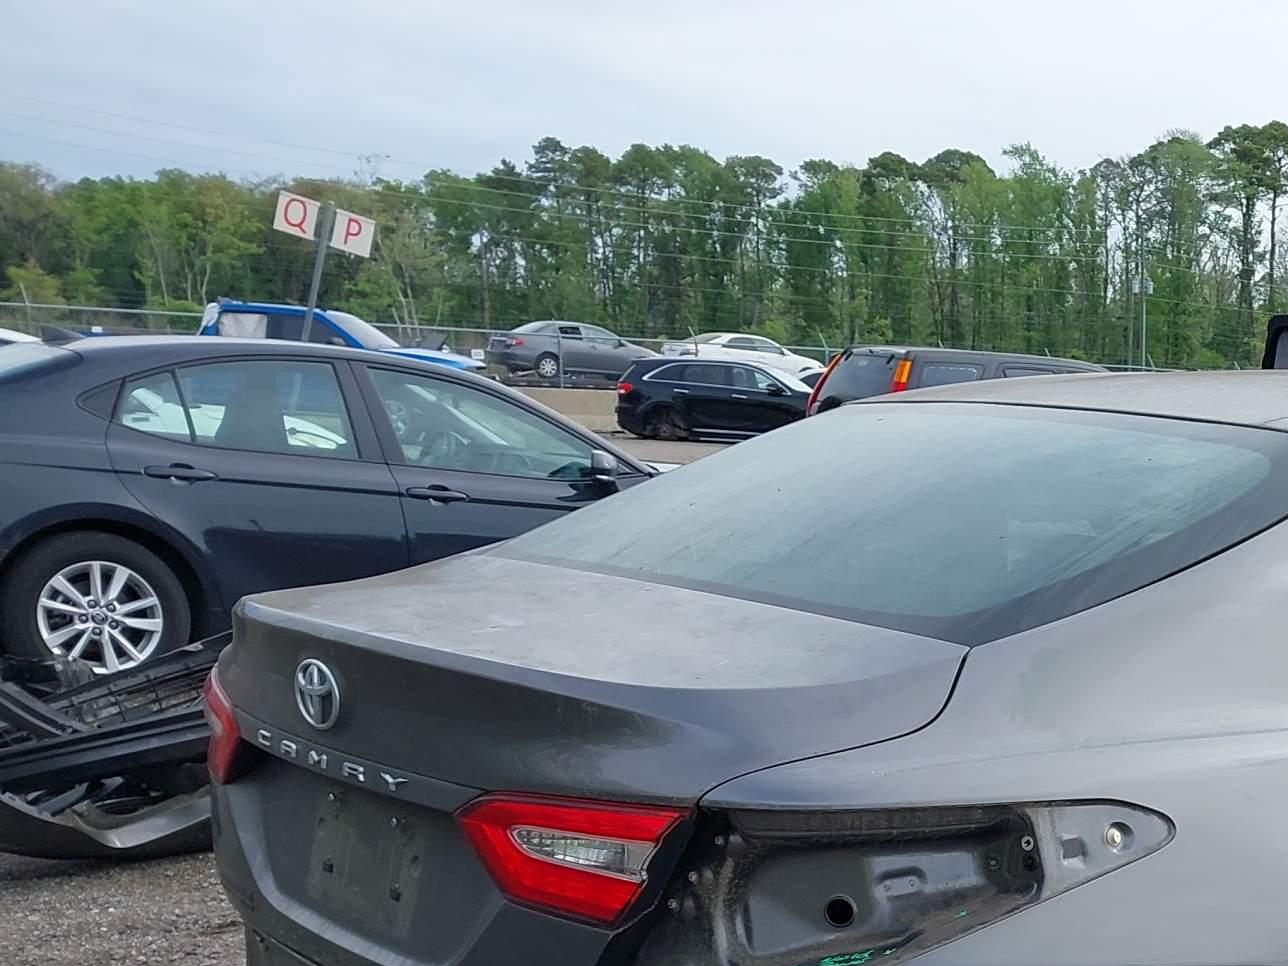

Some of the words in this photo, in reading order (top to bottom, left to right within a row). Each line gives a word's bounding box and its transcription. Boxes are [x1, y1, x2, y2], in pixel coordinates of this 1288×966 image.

[284, 199, 307, 234] Q
[344, 218, 362, 245] P
[257, 729, 409, 792] CAMRY
